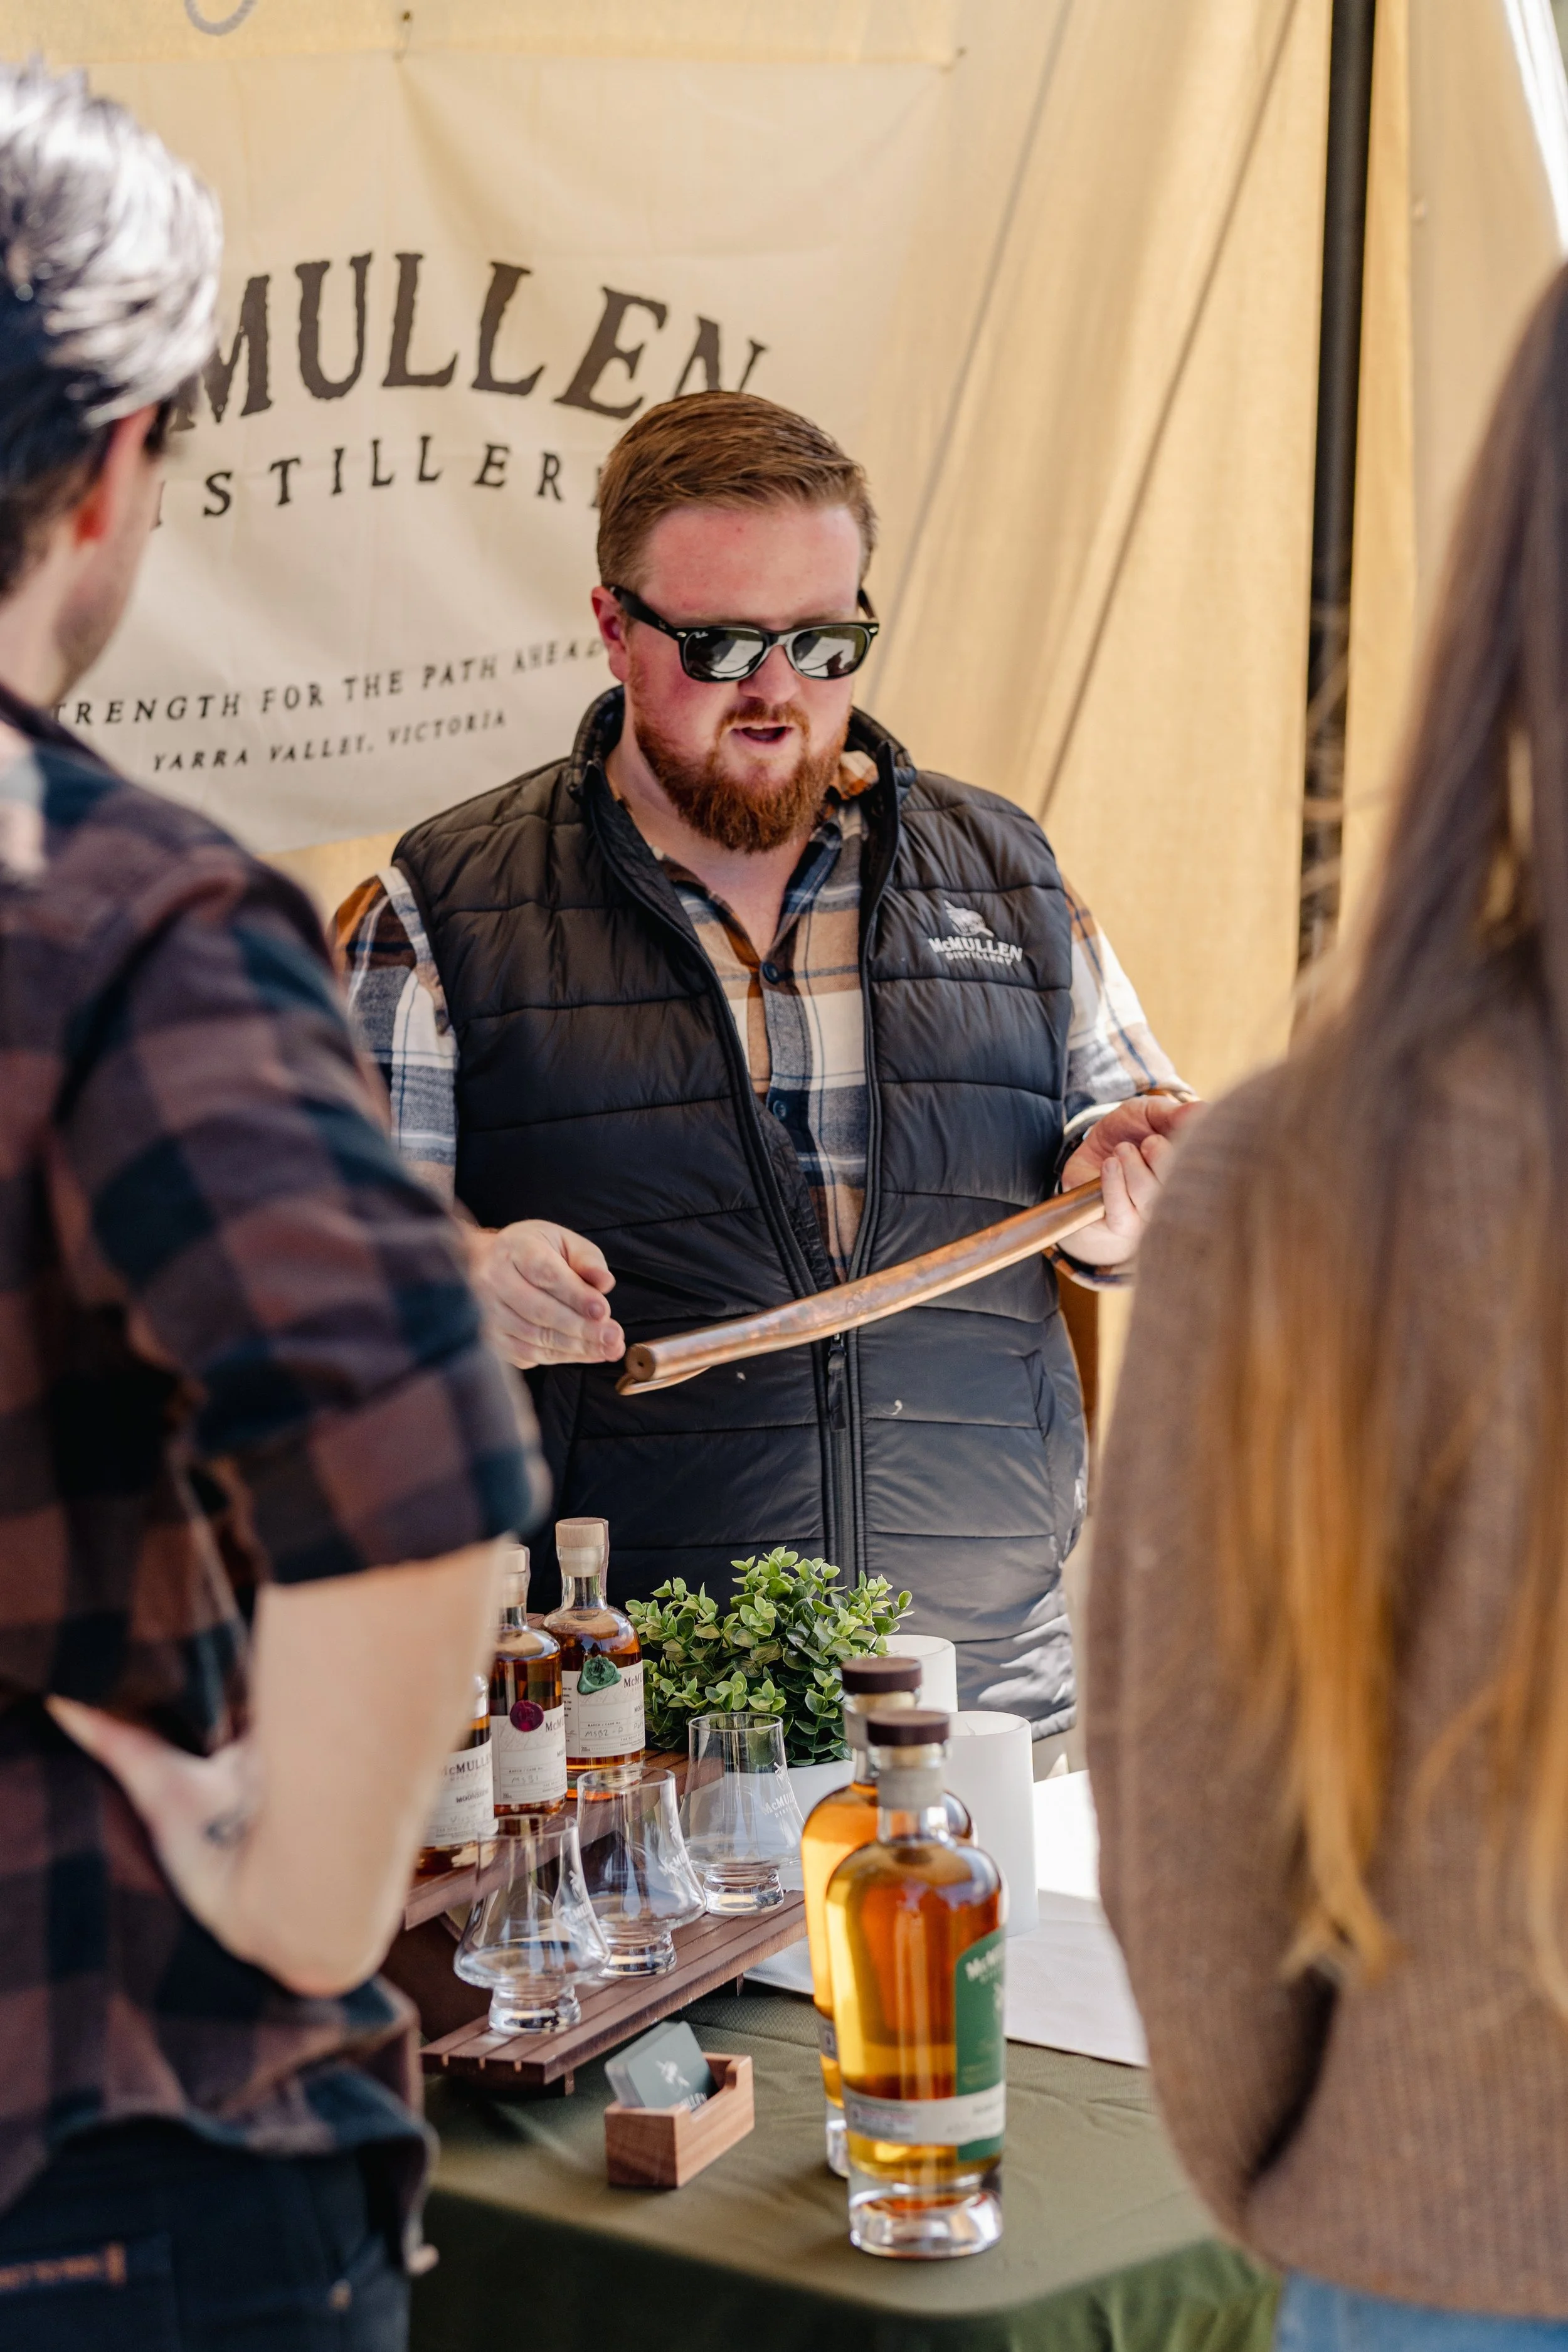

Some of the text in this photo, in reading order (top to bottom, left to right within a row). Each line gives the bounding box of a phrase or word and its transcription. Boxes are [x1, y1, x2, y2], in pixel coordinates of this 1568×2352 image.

[261, 682, 324, 714] FOR
[342, 669, 404, 702] THE
[422, 654, 498, 690] PATH
[511, 638, 605, 675] AHEAD
[154, 748, 248, 773] YARRA
[388, 709, 506, 746] VICTORIA
[928, 936, 1023, 962] McMULLEN
[945, 950, 1013, 967] DISTILLERY
